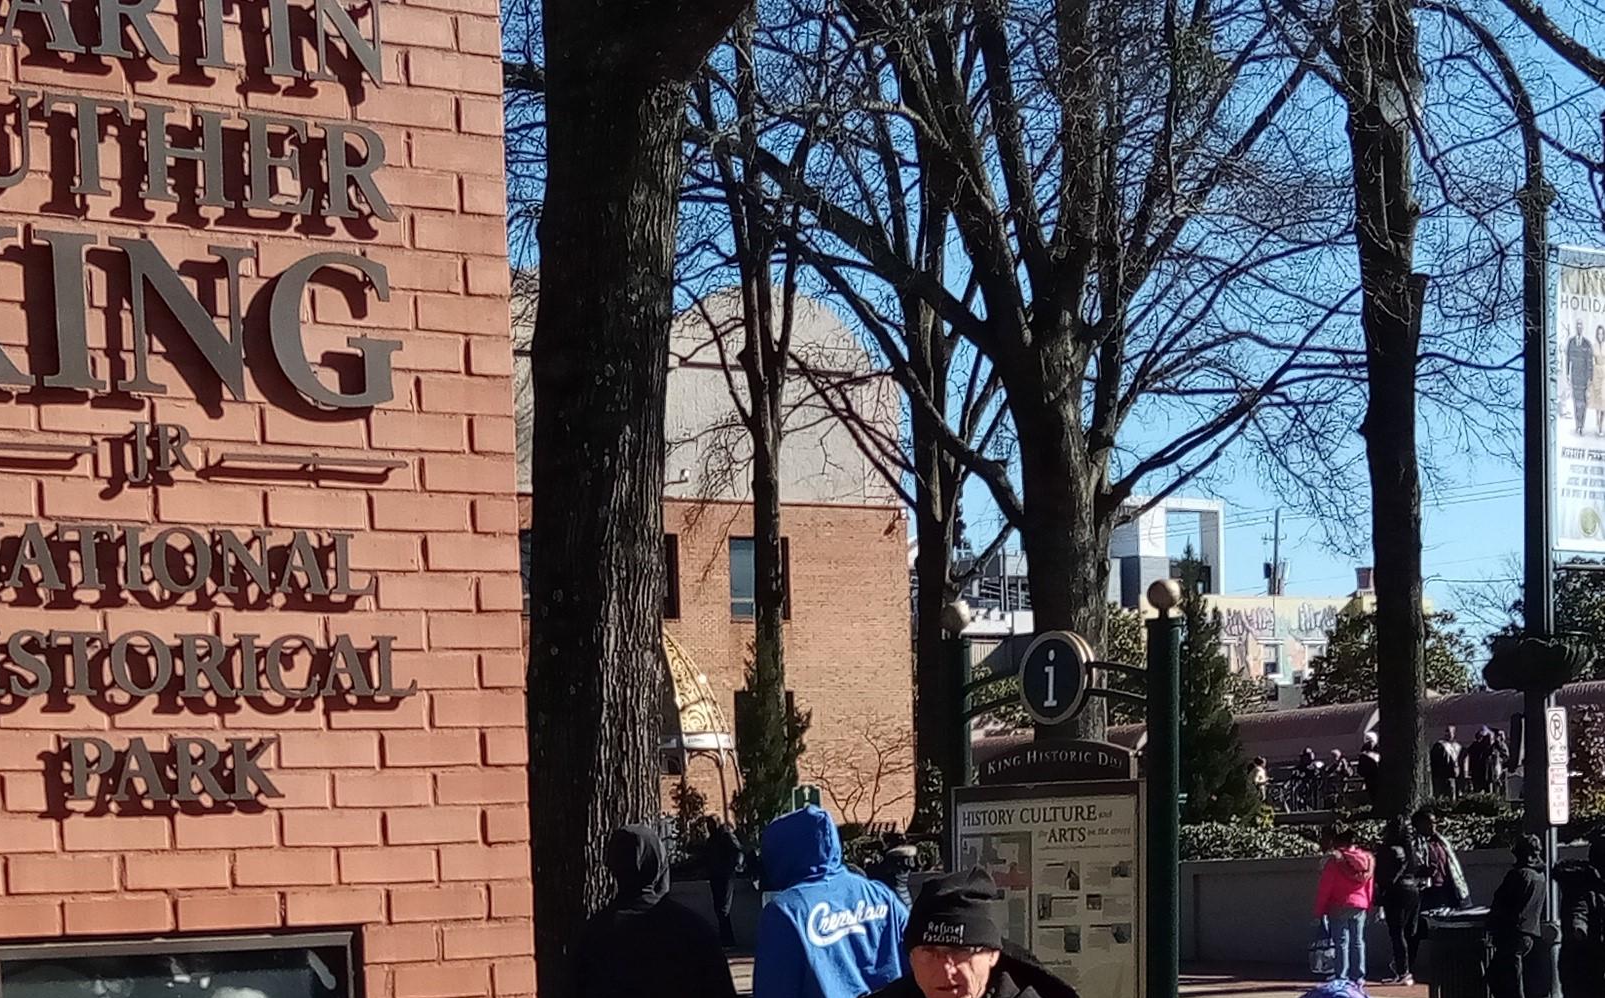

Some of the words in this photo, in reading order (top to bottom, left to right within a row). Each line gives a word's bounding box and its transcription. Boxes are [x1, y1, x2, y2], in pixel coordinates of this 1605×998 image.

[1561, 295, 1605, 313] HOLID
[128, 421, 196, 483] JR
[63, 737, 285, 801] PARK
[962, 810, 1015, 826] HISTORY
[1020, 805, 1097, 823] CULTURE
[1048, 827, 1086, 843] ARTS
